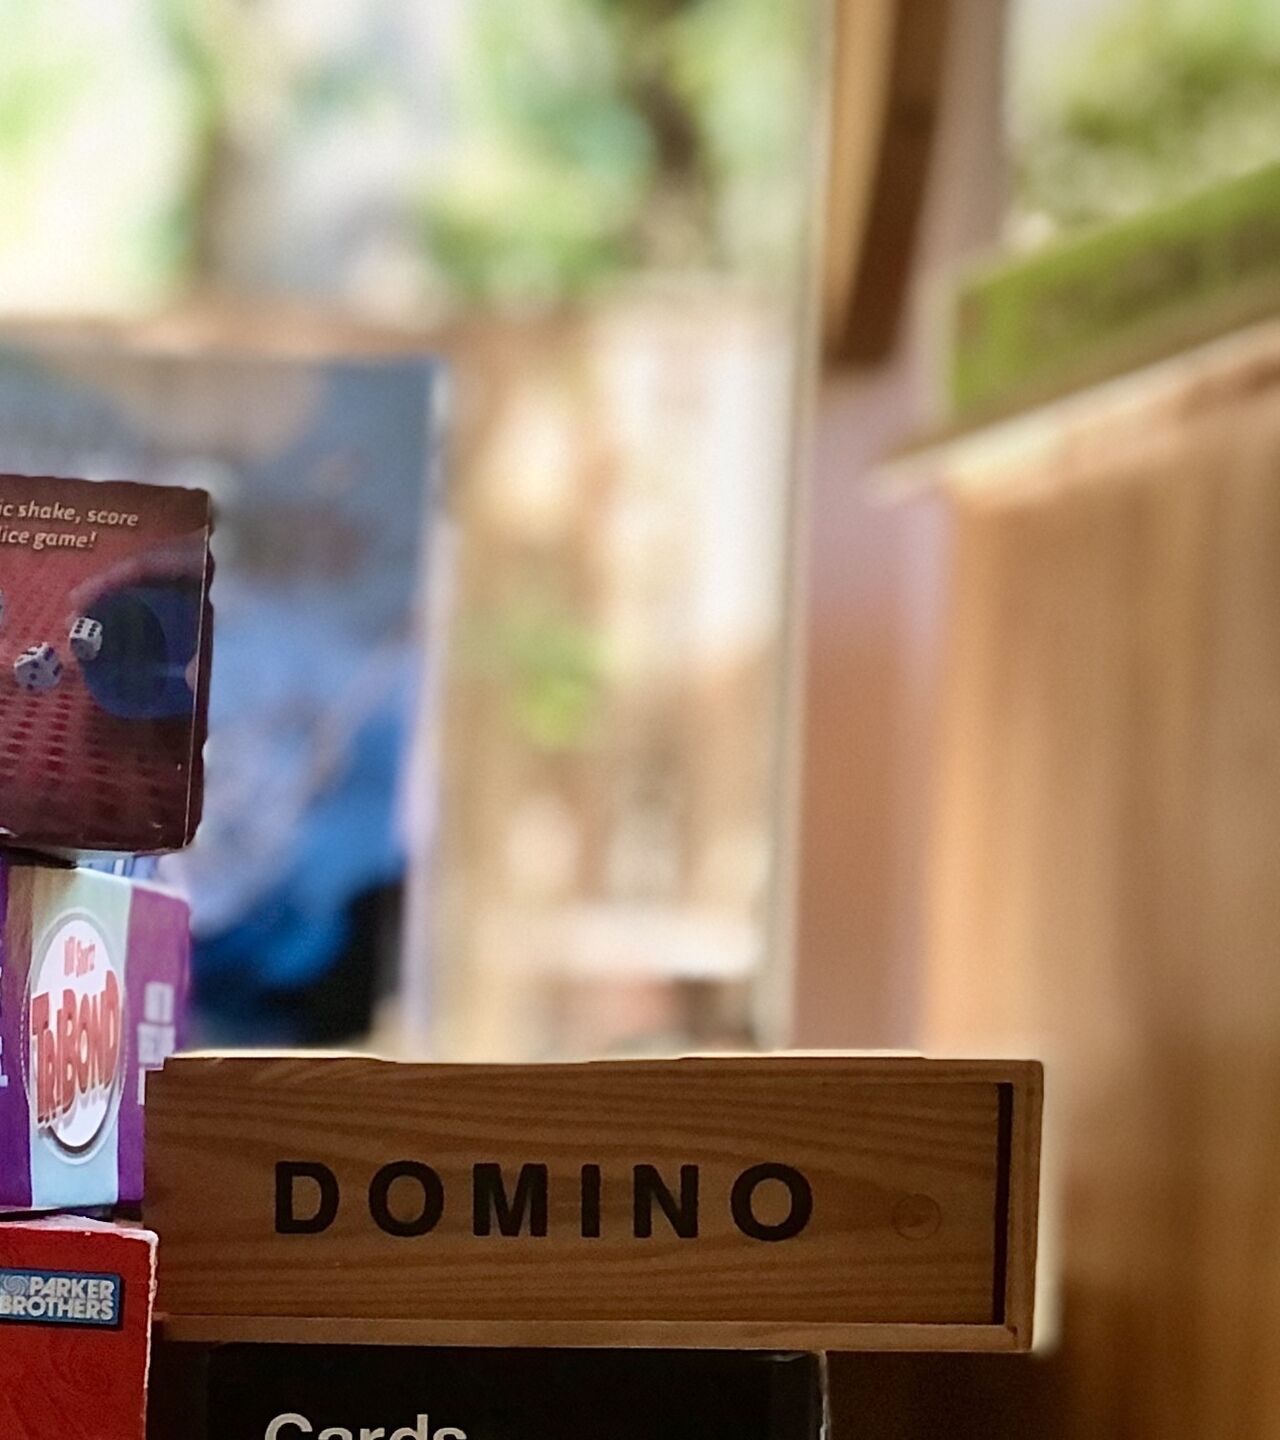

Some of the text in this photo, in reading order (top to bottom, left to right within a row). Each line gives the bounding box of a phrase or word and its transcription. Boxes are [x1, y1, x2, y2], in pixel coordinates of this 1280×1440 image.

[17, 500, 81, 524] shake,
[86, 508, 138, 527] score
[32, 530, 97, 550] game!
[274, 1160, 814, 1241] DOMINO
[30, 1276, 115, 1300] PARKER
[0, 1292, 114, 1320] BROTHERS
